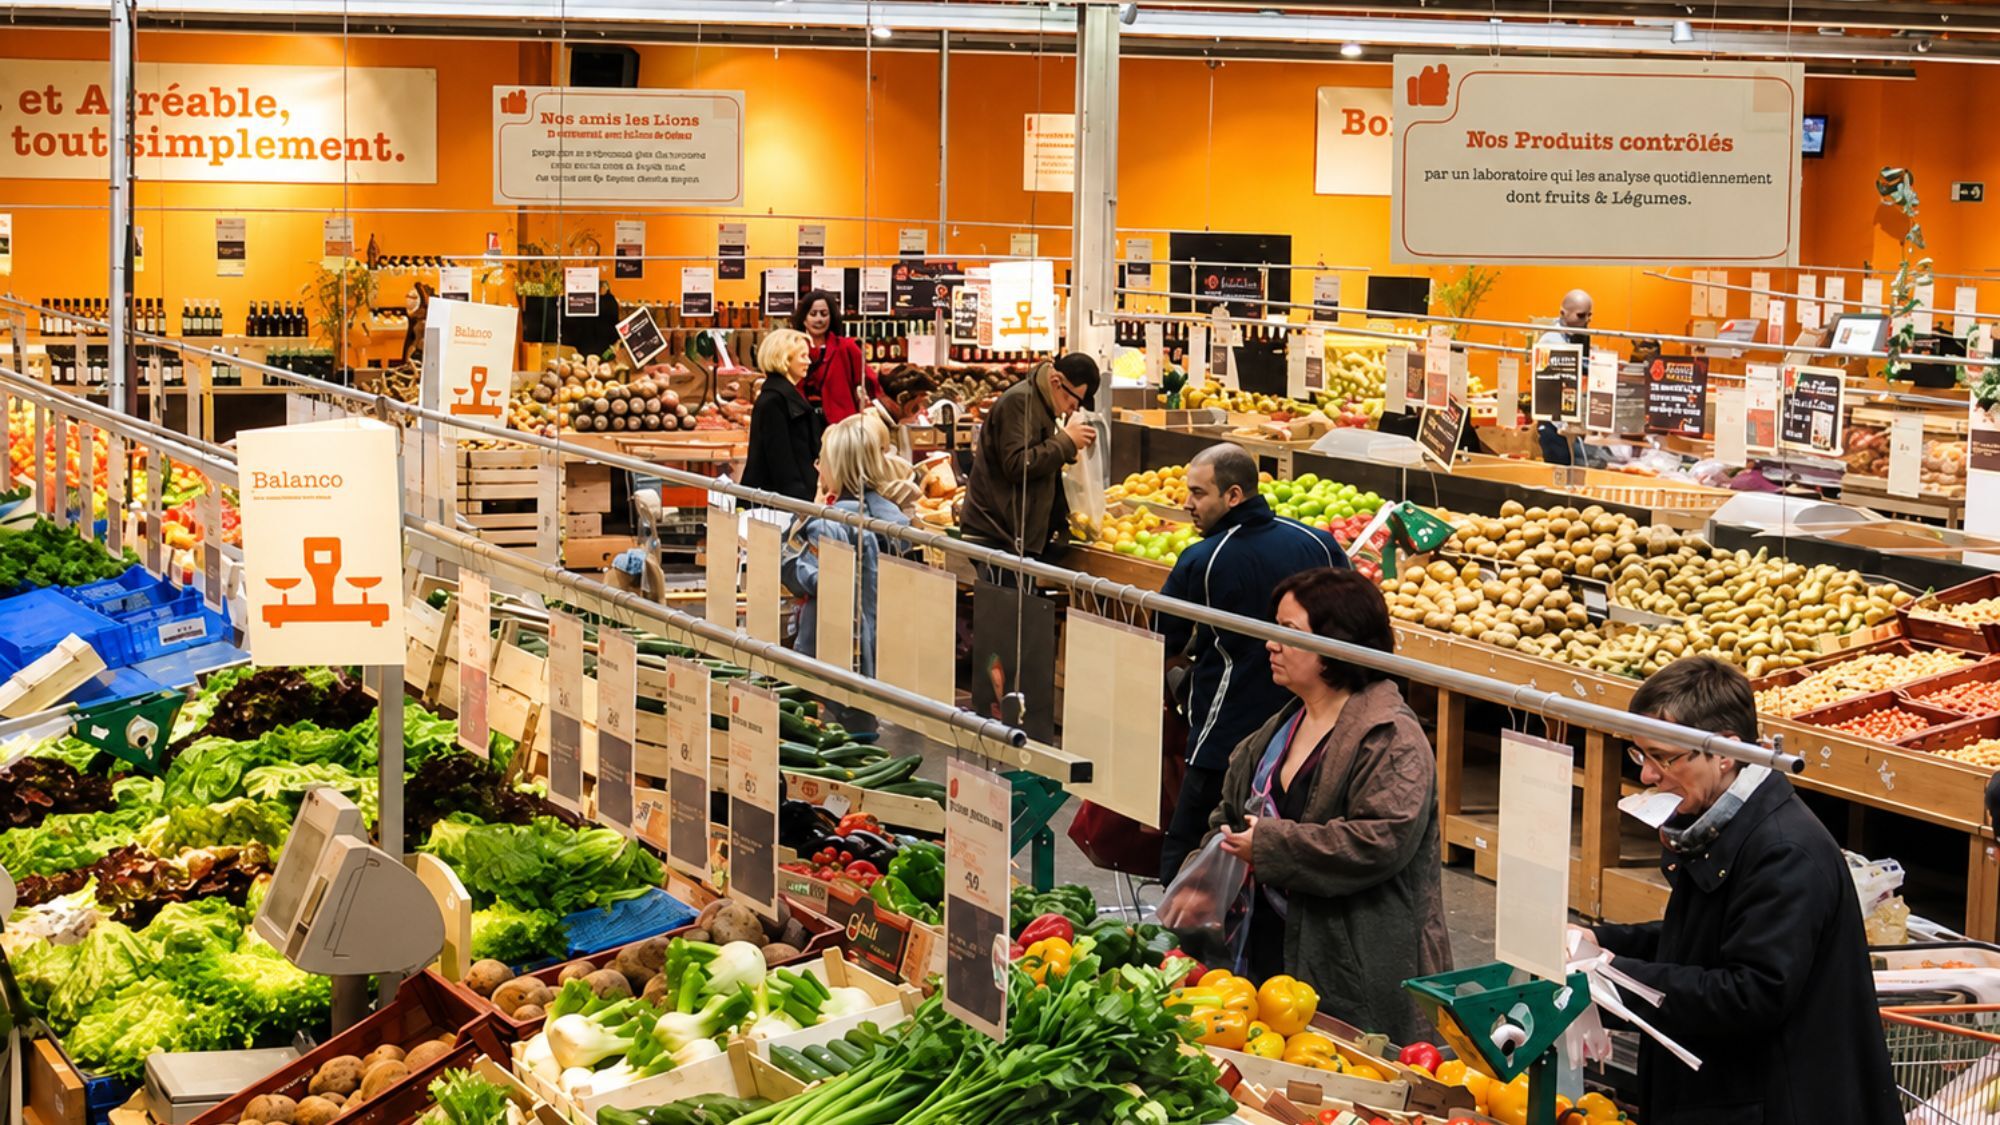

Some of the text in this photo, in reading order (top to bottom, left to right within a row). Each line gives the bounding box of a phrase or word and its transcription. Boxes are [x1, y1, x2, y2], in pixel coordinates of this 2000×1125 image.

[18, 83, 290, 126] et Aréable,
[540, 112, 700, 127] Nos amis les Lions
[1341, 108, 1393, 136] Bo
[11, 125, 109, 157] tout
[1466, 130, 1734, 152] Nos Produits contrôlés
[1424, 169, 1449, 182] par
[1451, 170, 1470, 180] un
[1473, 168, 1548, 182] laboratoire
[1550, 169, 1573, 184] qui
[1575, 169, 1596, 182] les
[1598, 170, 1650, 186] analyse
[1505, 190, 1692, 208] dont fruits & Légumes.
[251, 470, 344, 489] Balanco
